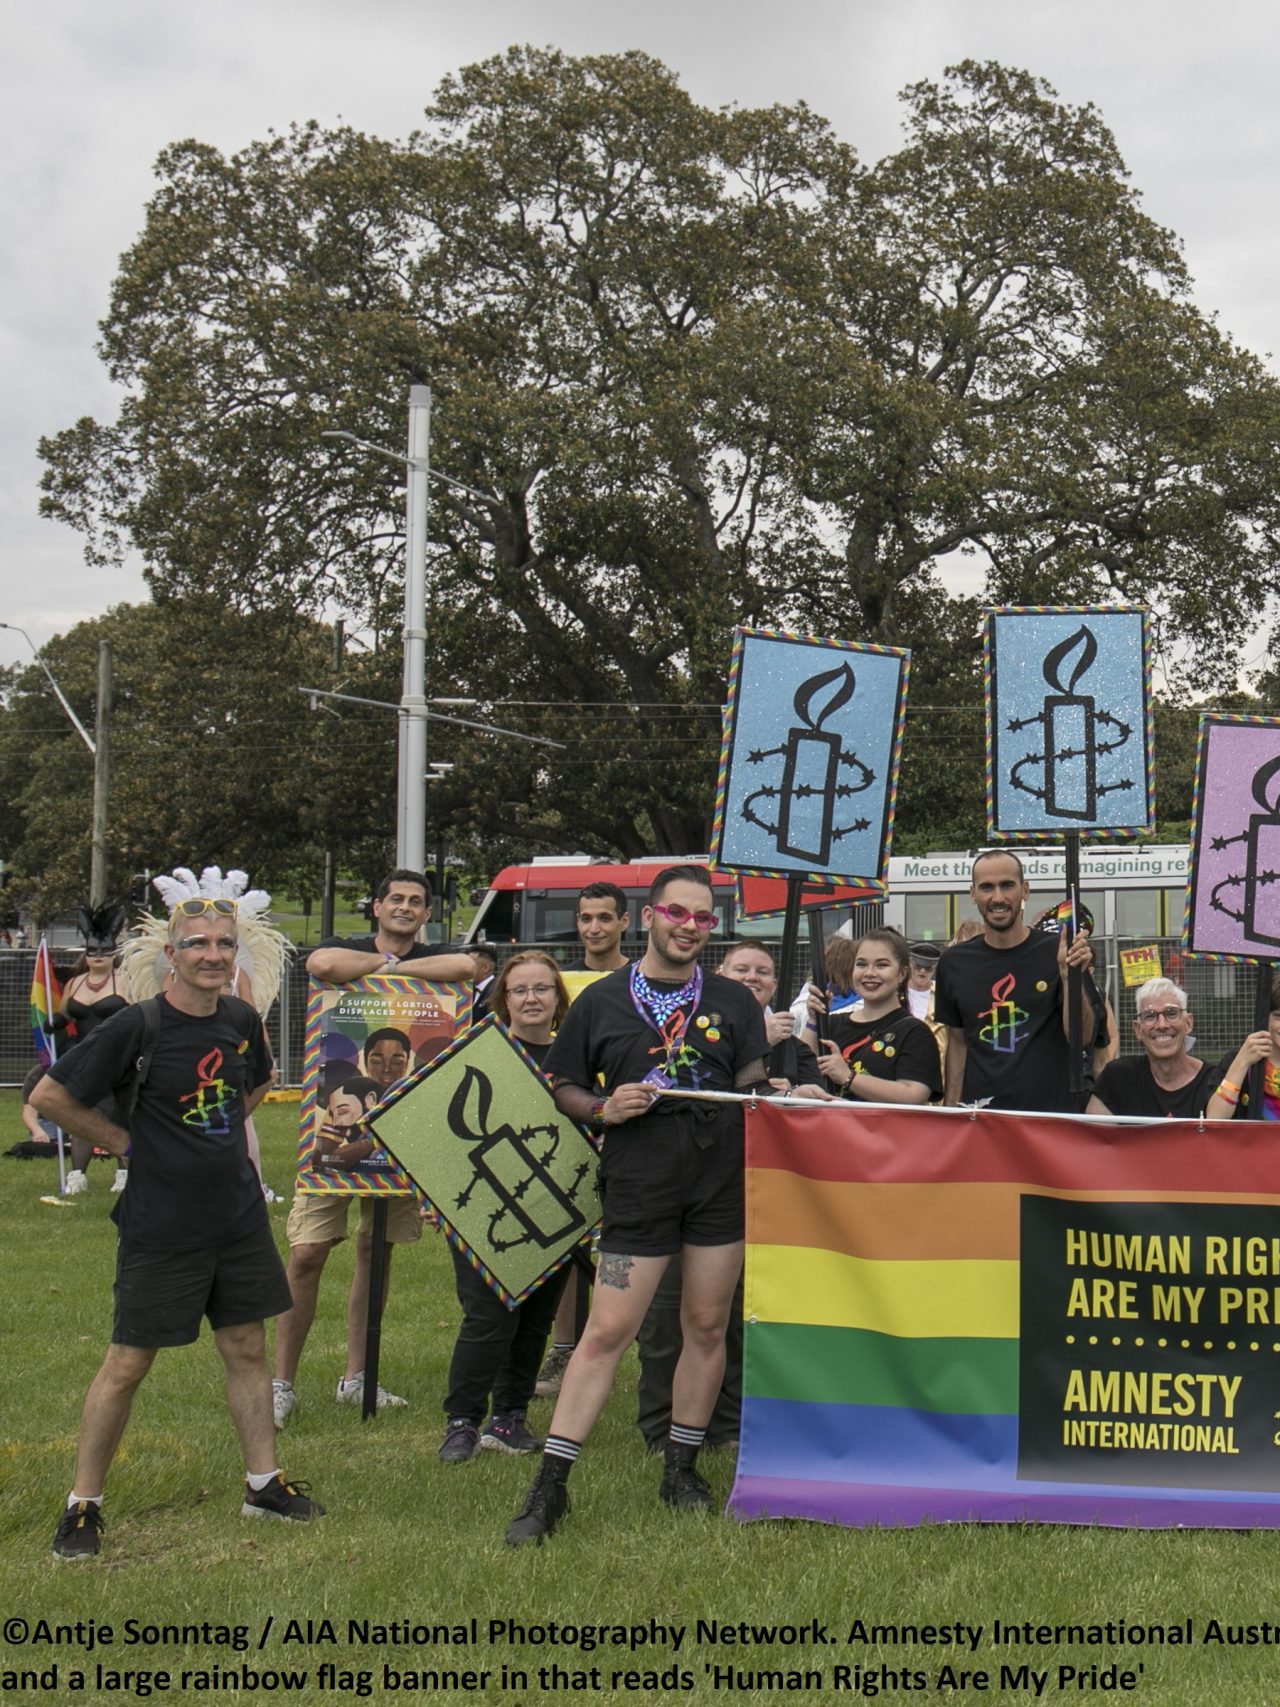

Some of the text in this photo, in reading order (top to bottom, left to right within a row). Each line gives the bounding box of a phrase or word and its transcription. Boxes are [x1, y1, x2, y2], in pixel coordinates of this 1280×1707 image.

[904, 862, 950, 877] Meet
[953, 861, 972, 876] th
[1053, 857, 1163, 876] remagining
[339, 1007, 440, 1018] DISPLACED PEOPLE
[347, 999, 393, 1008] SUPPORT
[396, 1000, 440, 1010] LGBTIQ+
[1066, 1228, 1191, 1274] HUMAN
[1066, 1277, 1140, 1319] ARE
[1152, 1283, 1206, 1324] MY
[1063, 1369, 1243, 1418] AMNESTY
[1063, 1419, 1240, 1454] INTERNATIONAL
